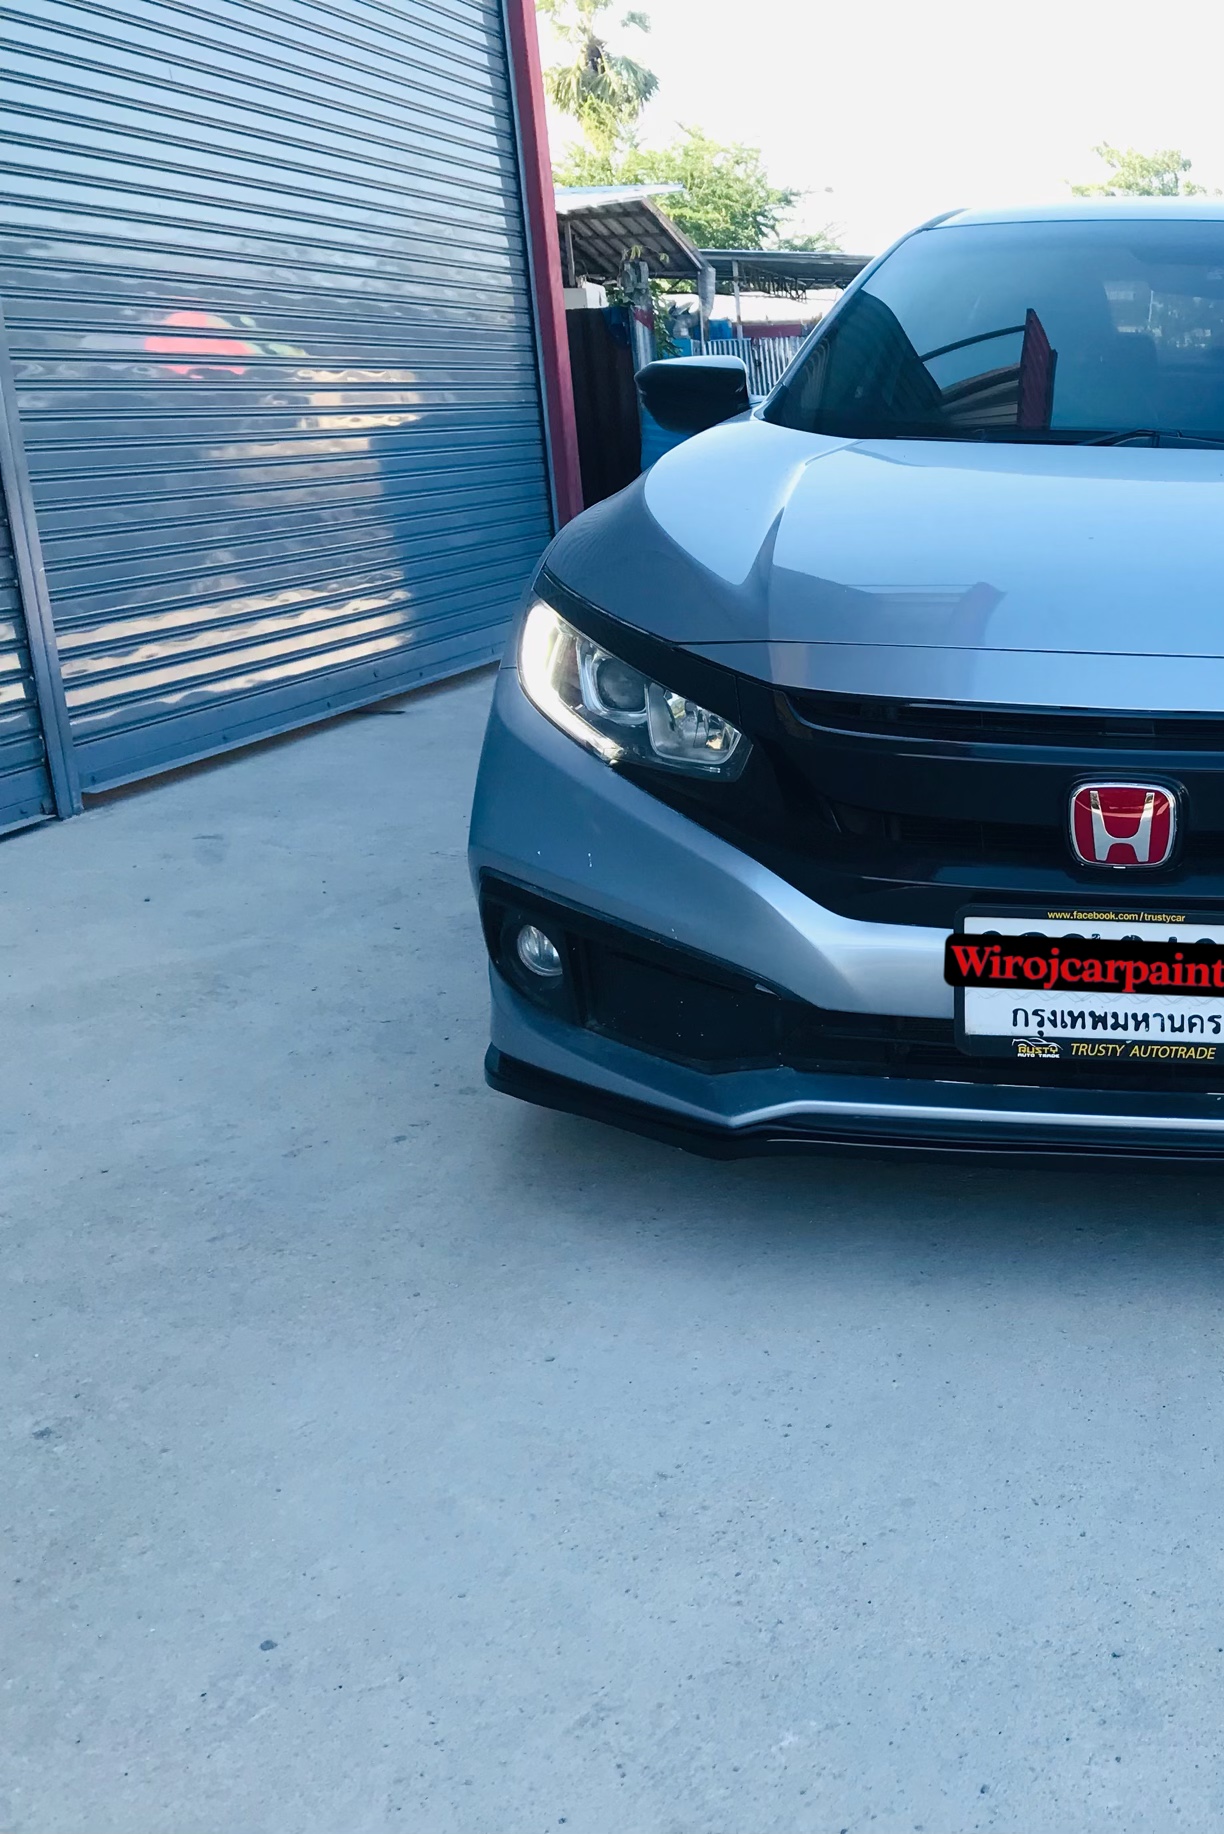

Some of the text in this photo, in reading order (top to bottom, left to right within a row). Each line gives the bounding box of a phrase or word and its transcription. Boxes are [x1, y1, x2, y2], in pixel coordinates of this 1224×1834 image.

[1047, 910, 1186, 923] www.facebook.com/trustycar
[1012, 1007, 1222, 1037] กรุงเทพมหานคร
[1071, 1043, 1217, 1060] TRUSTY AUTOTRADE
